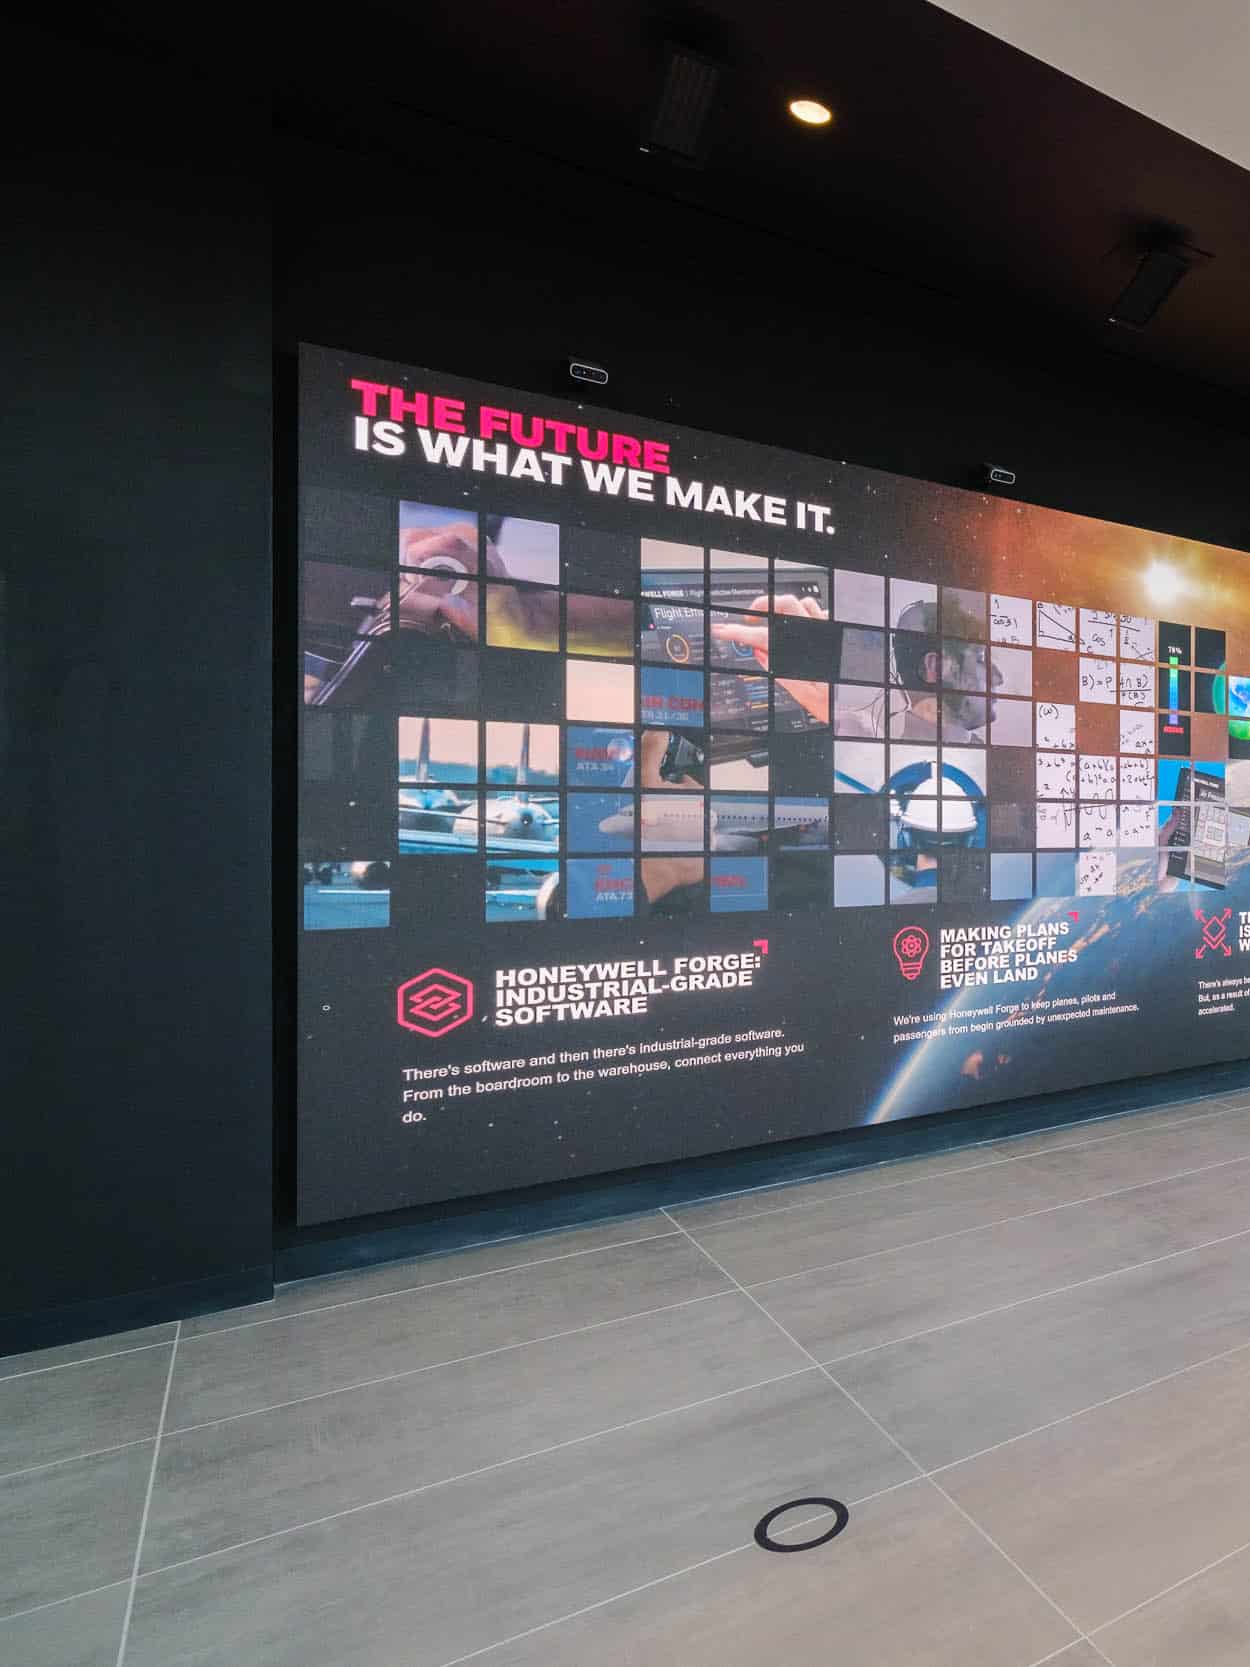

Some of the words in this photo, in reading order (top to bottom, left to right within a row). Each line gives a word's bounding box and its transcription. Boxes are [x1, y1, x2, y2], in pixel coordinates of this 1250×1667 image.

[350, 378, 466, 434] THE
[479, 405, 671, 474] FUTURE
[354, 416, 405, 456] IS
[418, 429, 572, 485] WHAT
[580, 460, 654, 501] WE
[666, 476, 787, 526] MAKE
[796, 501, 835, 535] IT.
[654, 607, 682, 620] Flight
[940, 924, 1012, 943] MAKING
[1016, 922, 1070, 939] PLANS
[940, 941, 976, 959] FOR
[982, 937, 1057, 956] TAKEOFF
[495, 959, 667, 987] HONEYWELL
[674, 953, 761, 975] FORGE:
[940, 953, 1009, 974] BEFORE
[1015, 950, 1078, 968] PLANES
[940, 971, 988, 989] EVEN
[993, 967, 1038, 984] LAND
[495, 970, 753, 1008] INDUSTRIAL-GRADE
[495, 996, 648, 1027] SOFTWARE
[893, 1014, 920, 1026] We're
[923, 1010, 947, 1025] using
[951, 1004, 993, 1020] Honeywell
[995, 1003, 1019, 1017] Forge
[1021, 1001, 1029, 1010] to
[1031, 998, 1050, 1012] keep
[1081, 993, 1101, 1006] pilots
[1102, 991, 1116, 1002] and
[893, 1027, 946, 1045] passengers
[949, 1023, 968, 1035] from
[970, 1021, 993, 1036] begin
[995, 1015, 1034, 1031] grounded
[1035, 1014, 1046, 1025] by
[1047, 1008, 1091, 1024] unexpected
[402, 1064, 460, 1082] There's
[463, 1060, 526, 1075] software
[529, 1053, 556, 1067] and
[559, 1048, 589, 1062] then
[593, 1044, 636, 1060] there's
[639, 1033, 732, 1055] industrial-grade
[735, 1028, 785, 1043] software.
[402, 1087, 443, 1103] From
[448, 1082, 472, 1097] the
[476, 1073, 553, 1093] boardroom
[557, 1071, 570, 1083] to
[573, 1068, 594, 1081] the
[598, 1060, 671, 1078] warehouse,
[674, 1053, 722, 1068] connect
[724, 1044, 782, 1062] everything
[784, 1042, 805, 1056] you
[402, 1110, 427, 1124] do.
